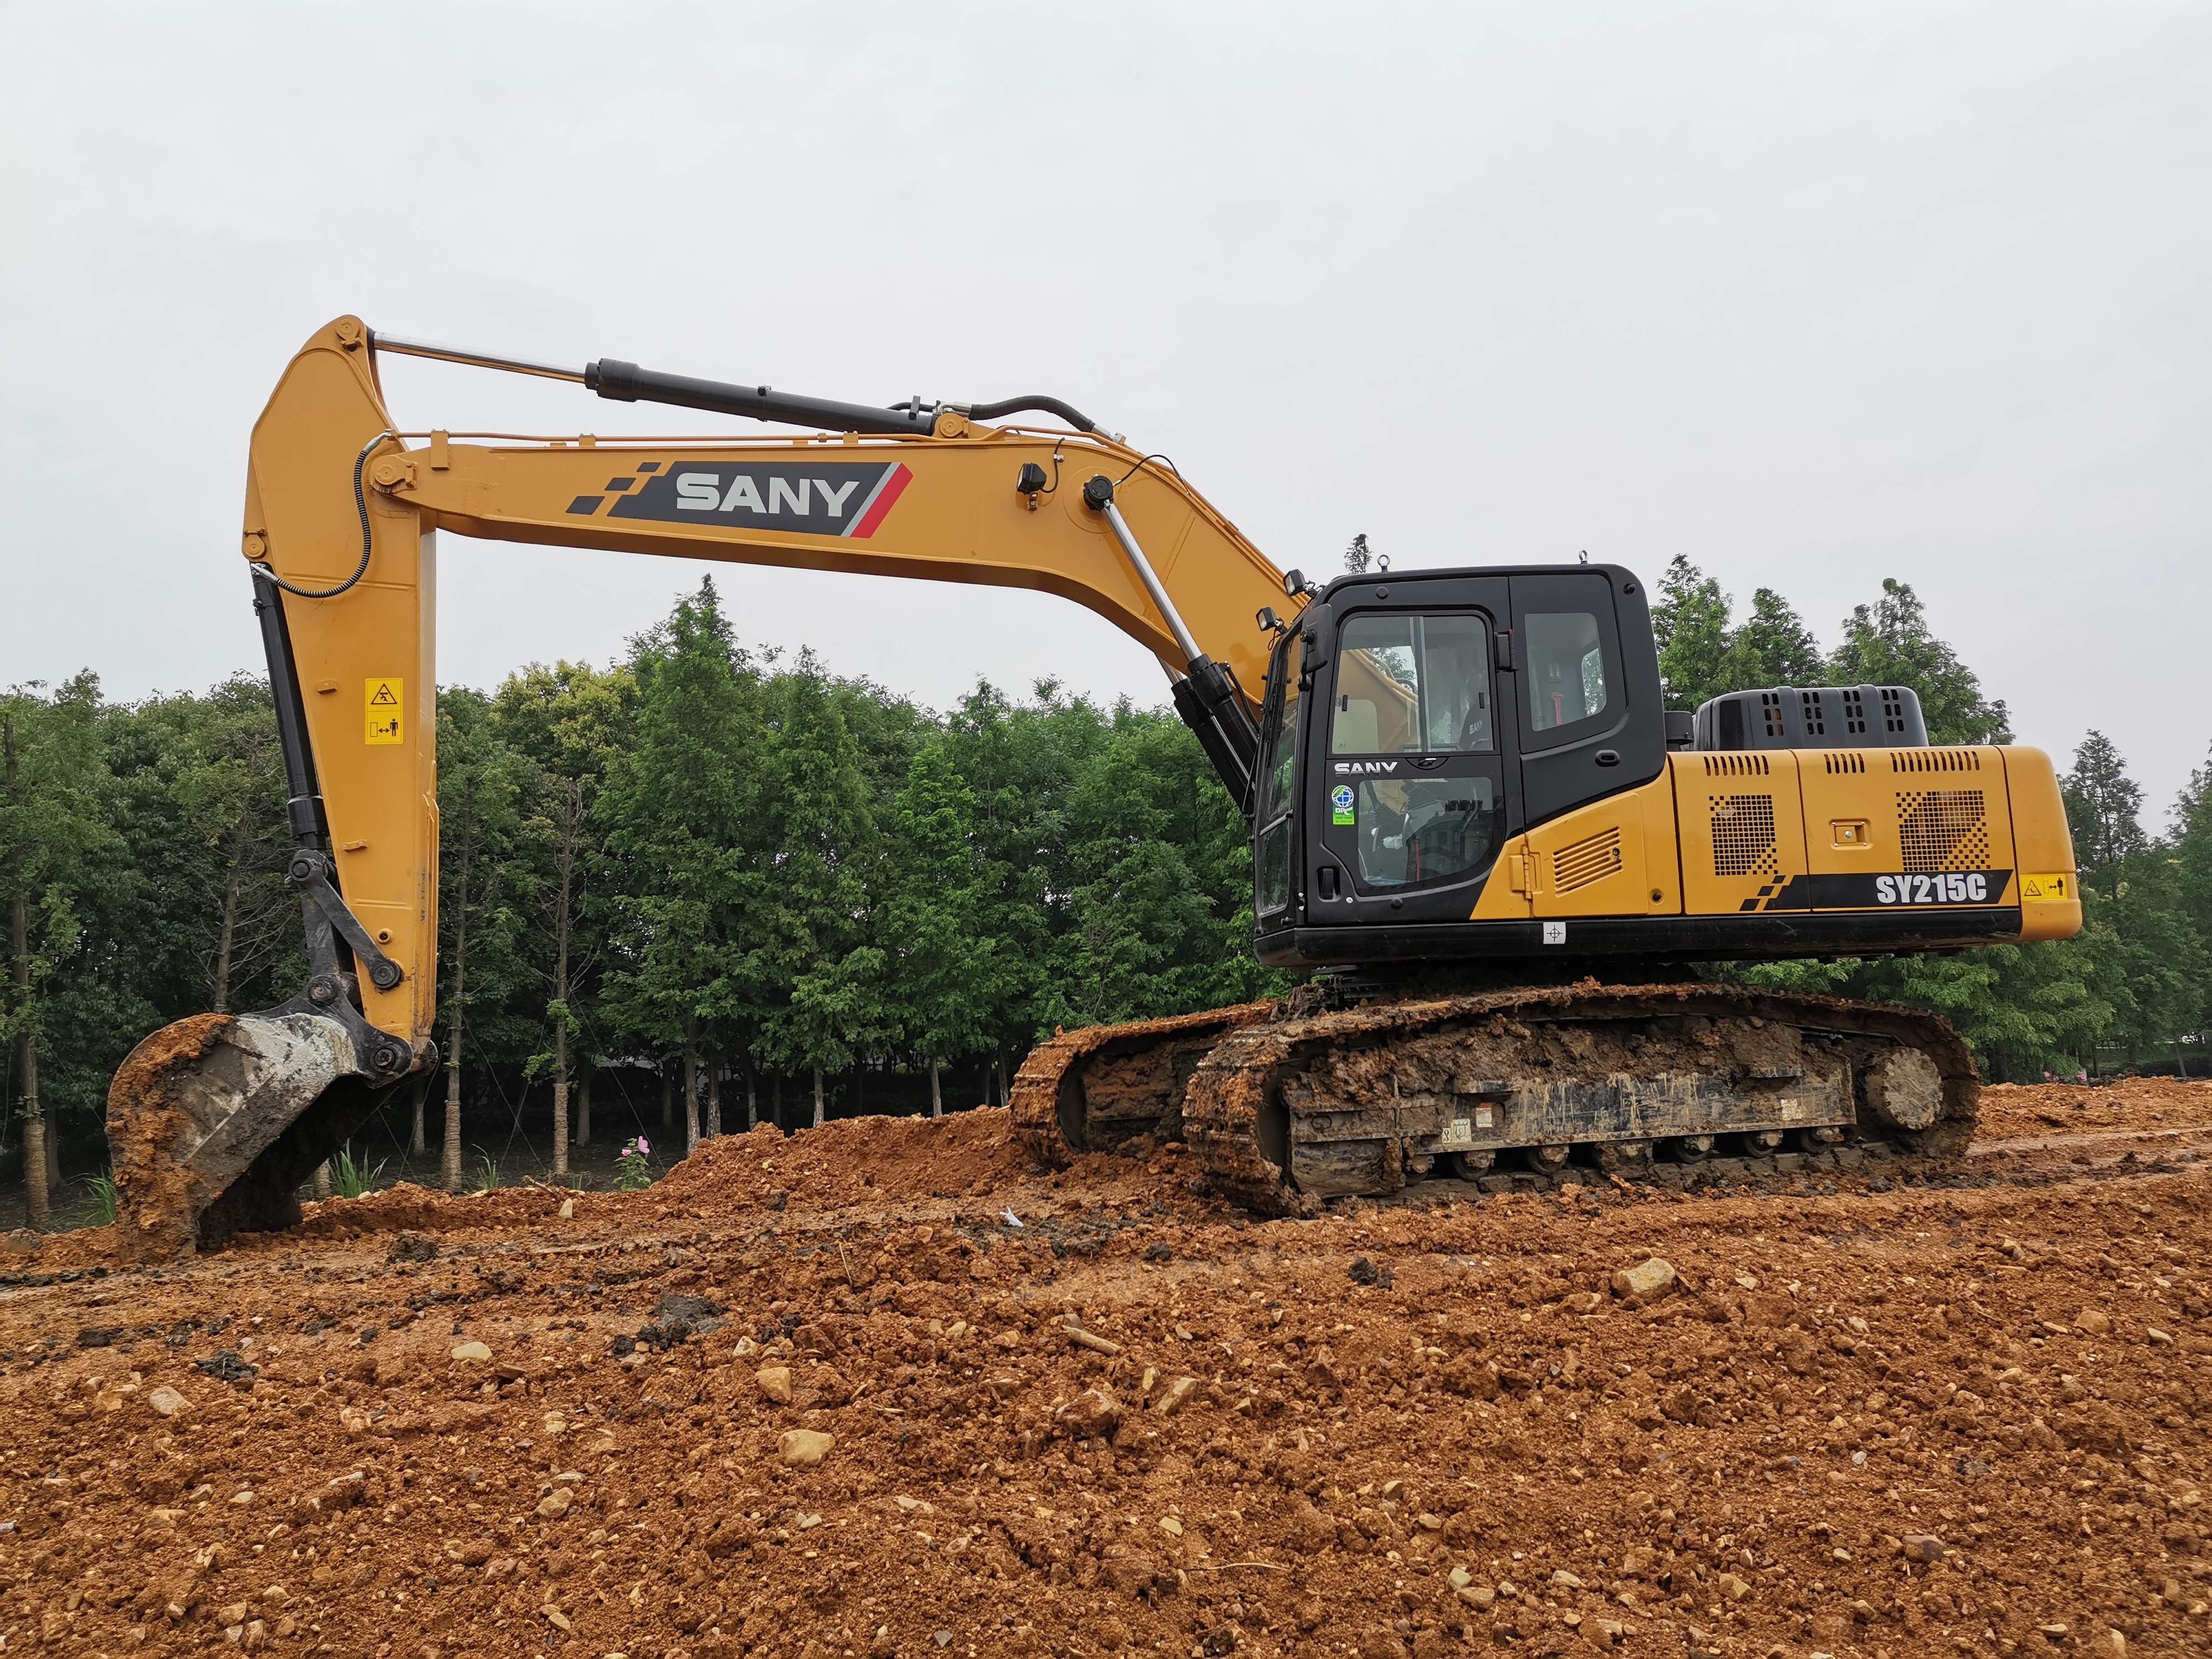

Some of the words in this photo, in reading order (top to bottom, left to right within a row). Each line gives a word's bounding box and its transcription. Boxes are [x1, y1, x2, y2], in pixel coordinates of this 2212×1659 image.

[676, 472, 860, 517] SANY
[1334, 761, 1398, 776] SANY
[1876, 873, 1987, 904] SY215C
